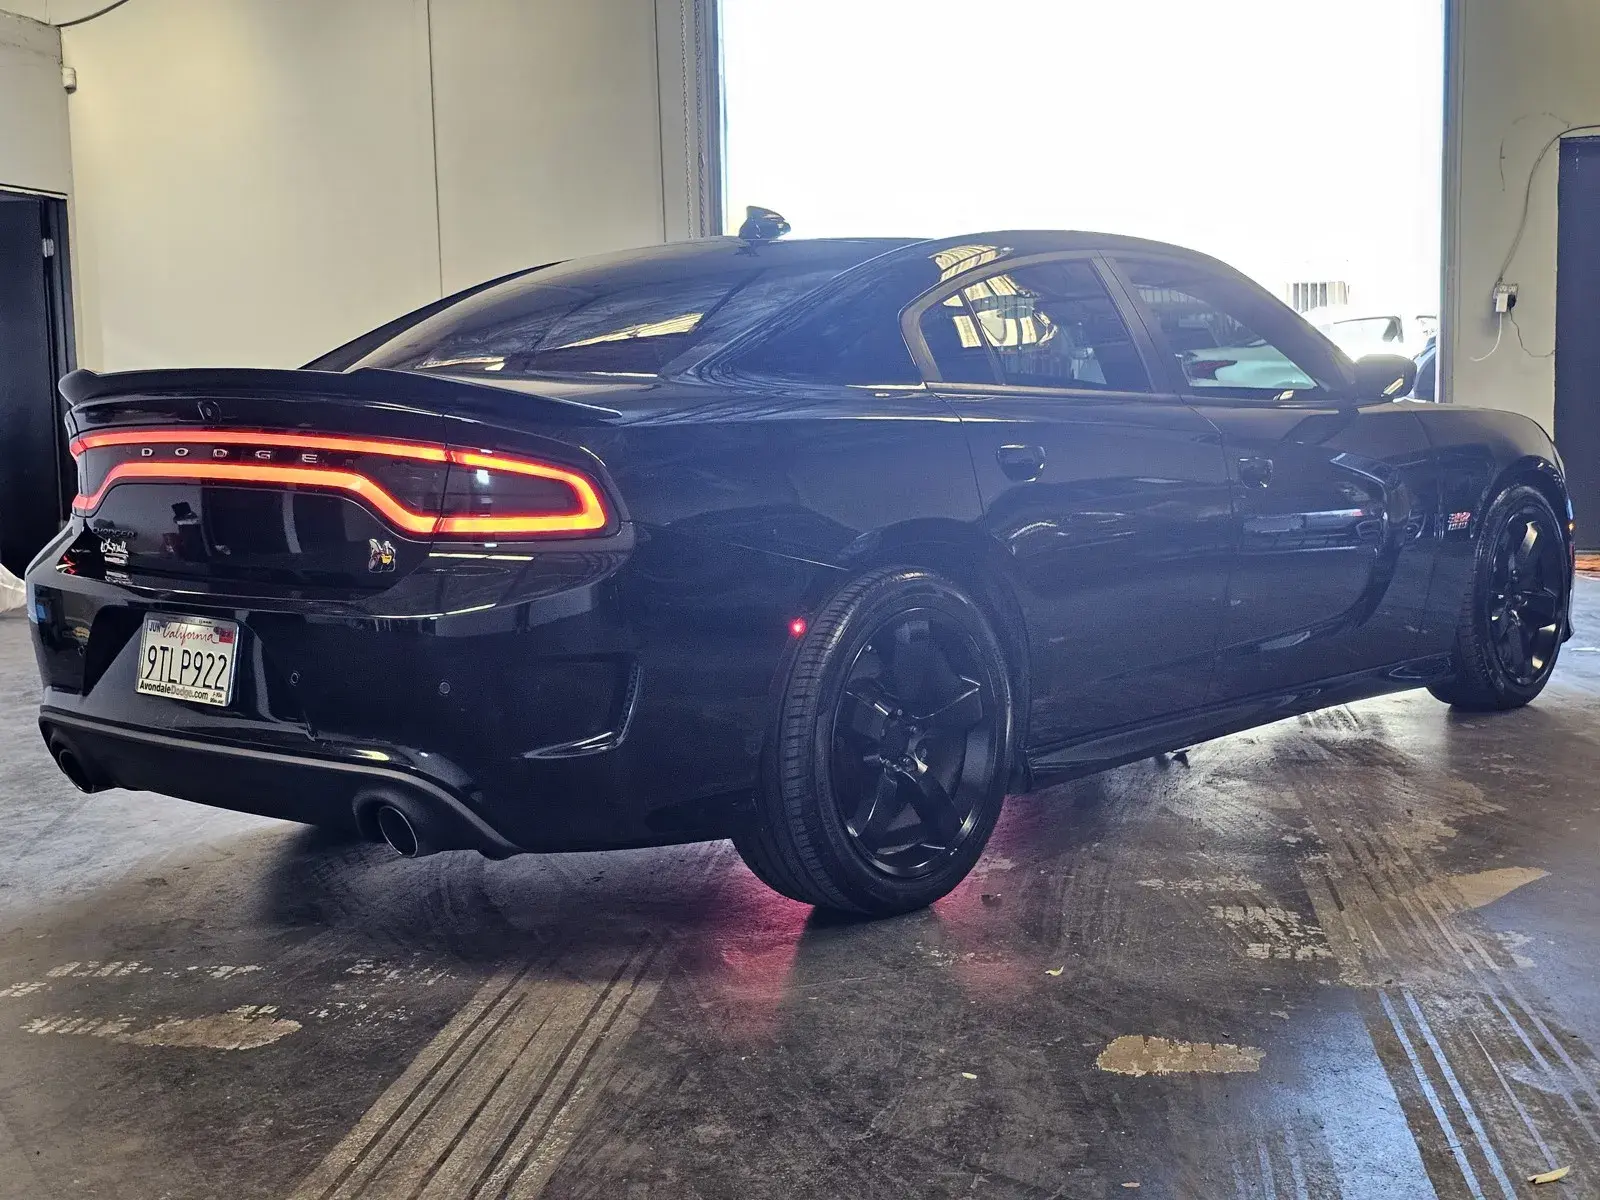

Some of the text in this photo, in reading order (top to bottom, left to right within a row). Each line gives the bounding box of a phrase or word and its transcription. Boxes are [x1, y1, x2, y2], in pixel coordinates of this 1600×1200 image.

[141, 447, 318, 464] DODGE
[162, 621, 219, 646] California
[145, 645, 228, 690] 9TLP922
[139, 680, 209, 700] AvondaleDodge.com
